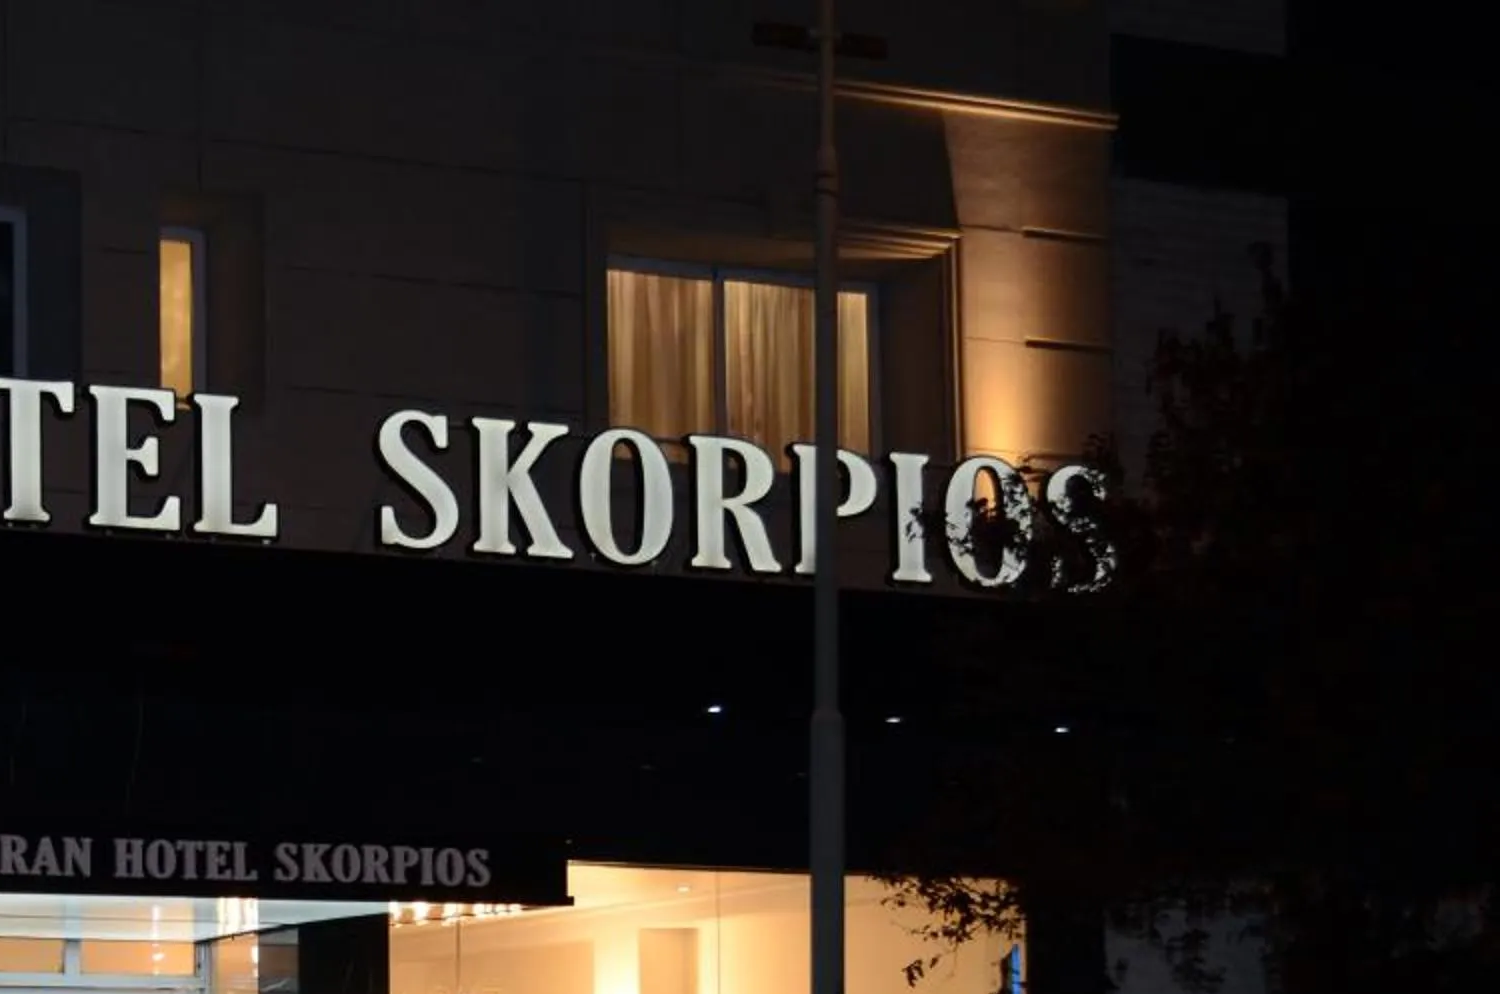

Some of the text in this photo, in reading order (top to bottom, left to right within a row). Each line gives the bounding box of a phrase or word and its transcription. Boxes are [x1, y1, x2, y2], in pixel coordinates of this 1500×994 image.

[378, 409, 1115, 593] SKORPIOS
[113, 838, 258, 881] HOTEL
[273, 842, 491, 887] SKORPIOS
